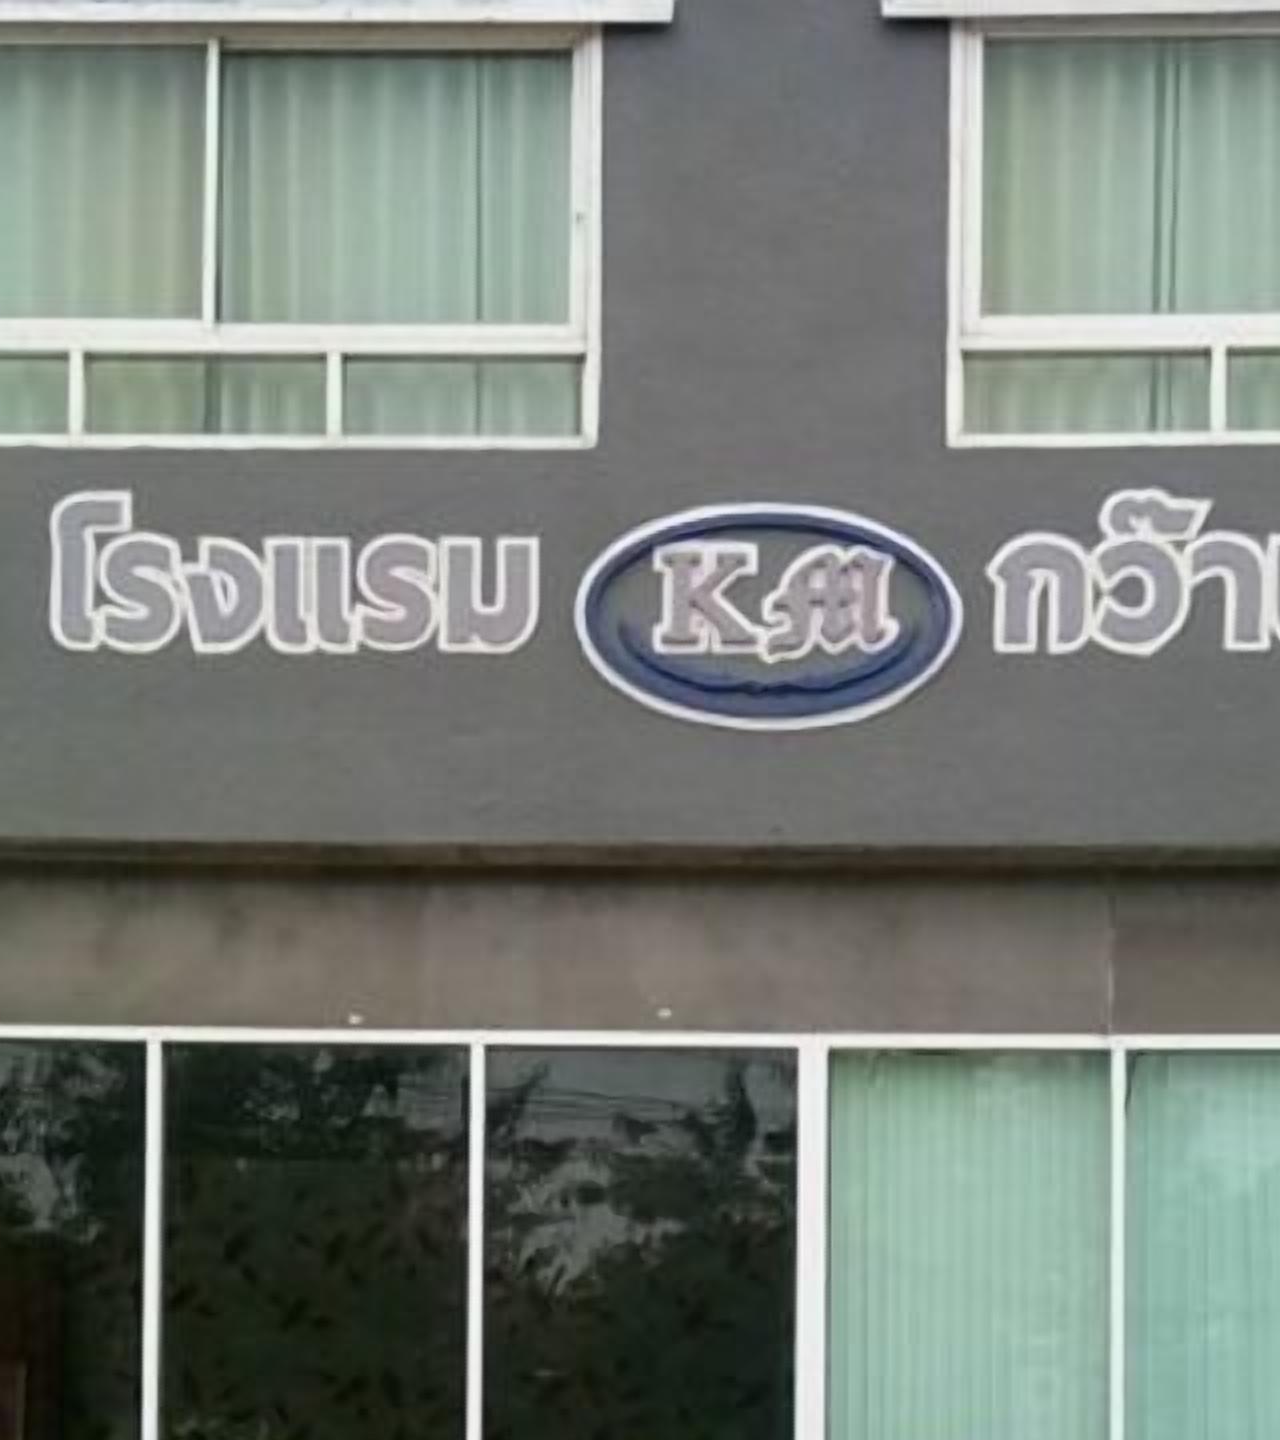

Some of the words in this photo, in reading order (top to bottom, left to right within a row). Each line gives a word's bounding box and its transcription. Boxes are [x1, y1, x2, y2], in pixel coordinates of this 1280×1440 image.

[50, 490, 540, 653] โรงแรม
[653, 540, 900, 663] KM
